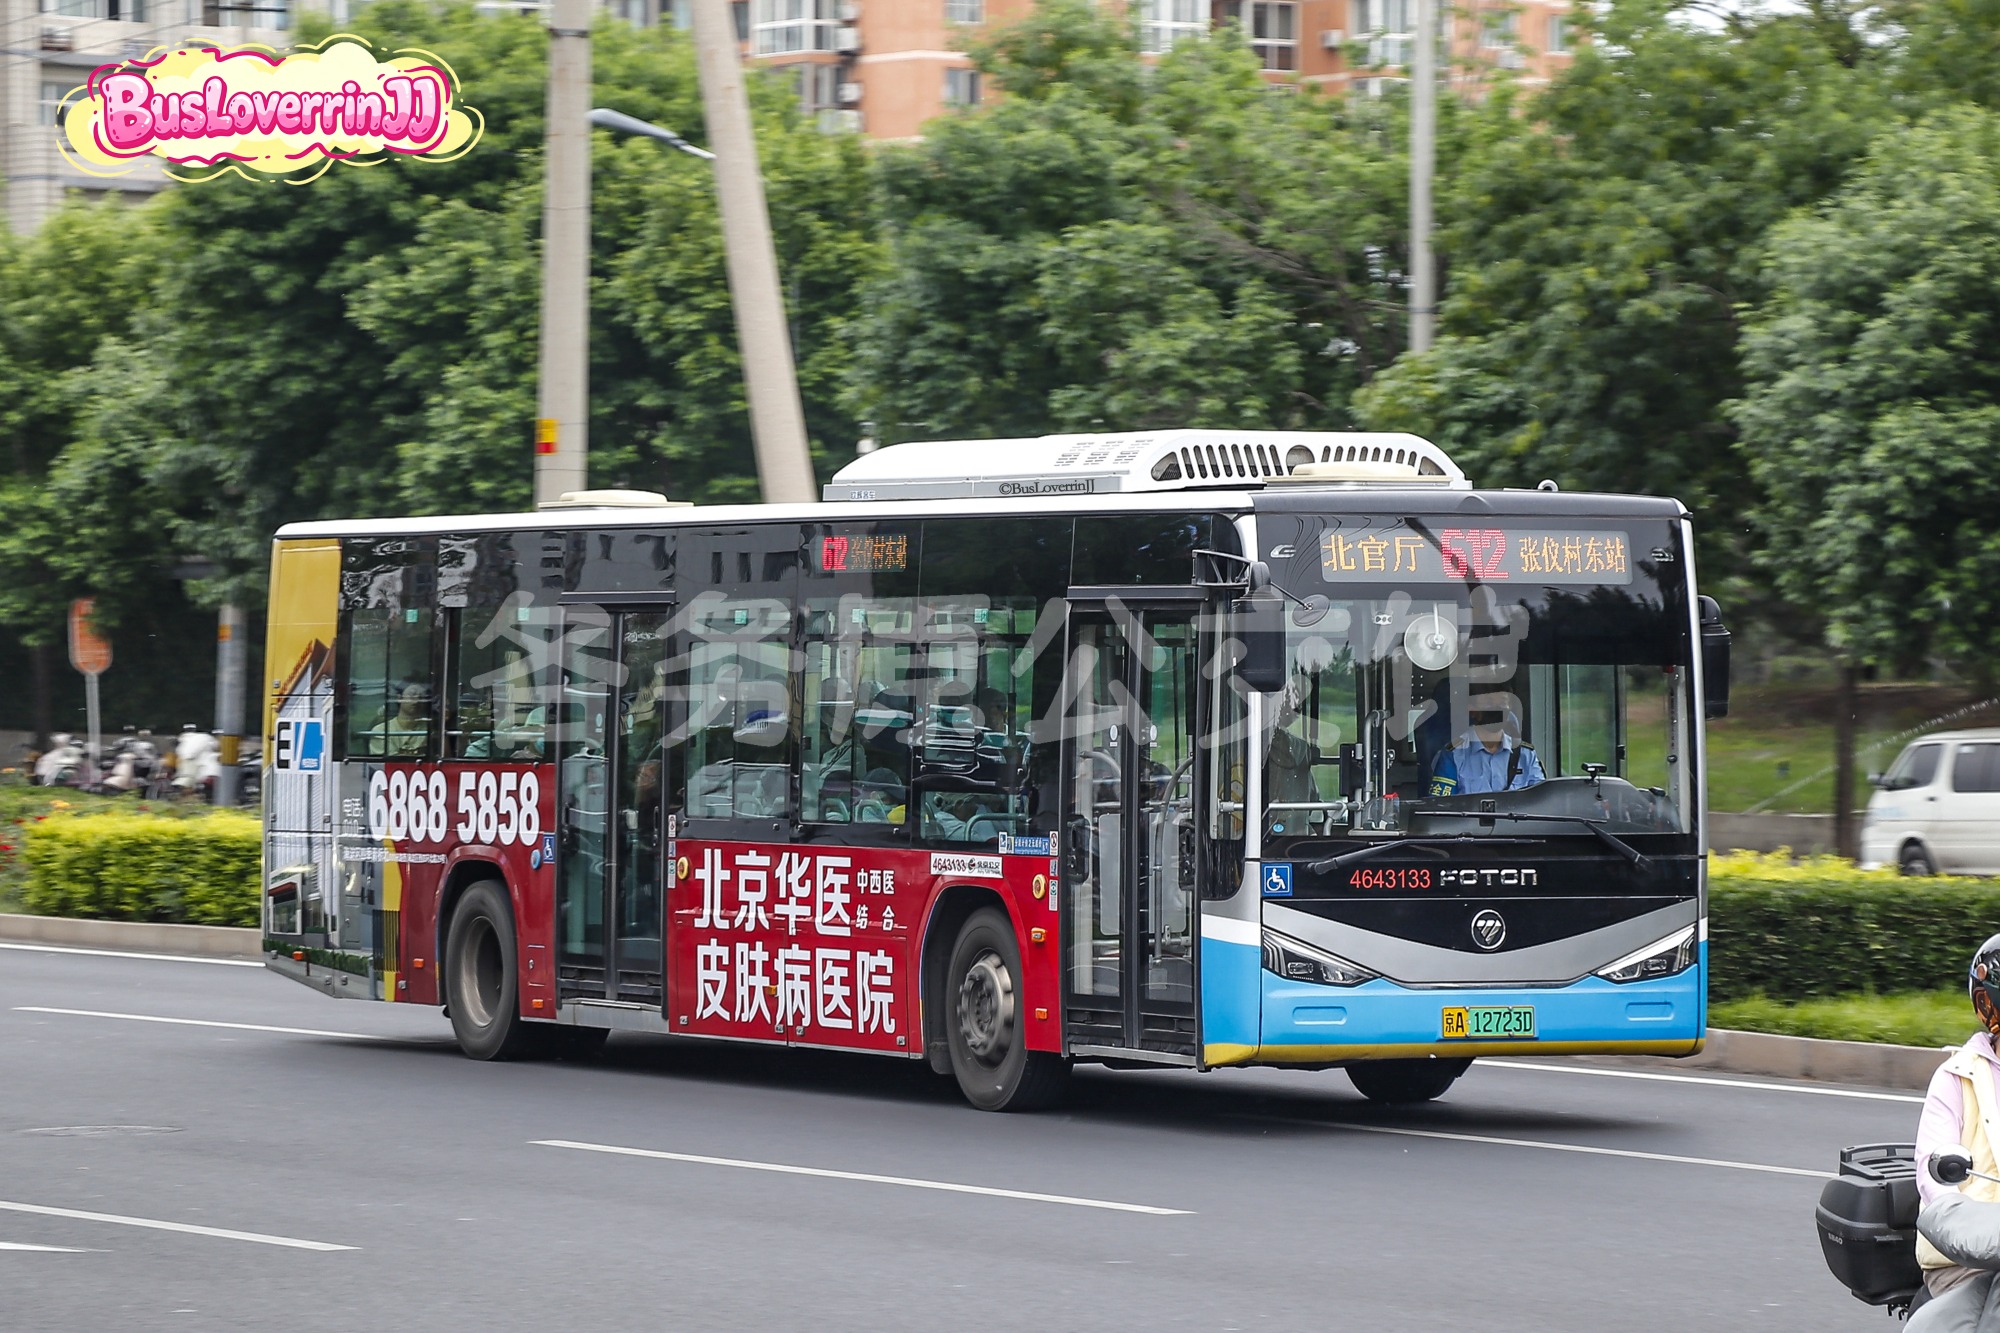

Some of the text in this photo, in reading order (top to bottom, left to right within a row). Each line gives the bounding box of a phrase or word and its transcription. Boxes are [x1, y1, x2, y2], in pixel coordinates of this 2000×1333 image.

[822, 536, 848, 570] 612
[1322, 529, 1627, 579] 北官厅 612 张仪村东站
[1429, 783, 1453, 796] 全员
[369, 770, 541, 846] 6868 5858
[932, 857, 967, 872] 4643133
[1349, 869, 1538, 889] 4643133 FOTON
[694, 848, 852, 936] 北京华医
[856, 868, 895, 895] 中西医
[695, 939, 896, 1034] 皮肤病医院
[1445, 1011, 1533, 1033] 京A 12723D
